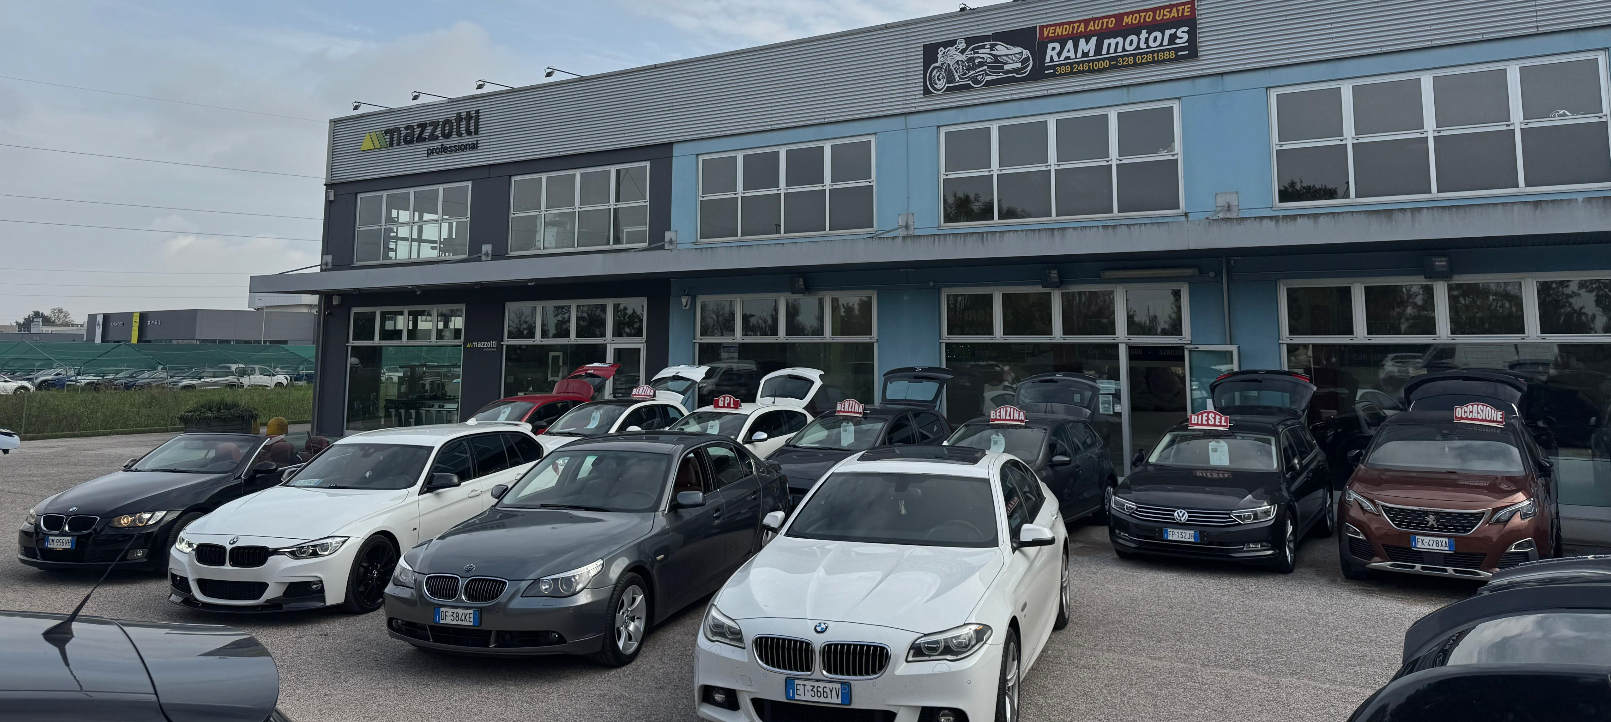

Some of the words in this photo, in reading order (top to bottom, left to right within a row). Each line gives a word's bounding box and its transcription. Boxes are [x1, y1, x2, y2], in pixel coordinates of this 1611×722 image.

[1043, 23, 1085, 37] VENDITA
[1087, 18, 1115, 31] AUTO
[1123, 12, 1153, 25] MOTO
[1156, 5, 1191, 20] USATE
[1045, 36, 1097, 63] RAM
[1102, 27, 1190, 54] motors
[1055, 65, 1071, 75] 389
[1073, 60, 1109, 72] 2461000
[1117, 56, 1133, 66] 328
[1136, 50, 1176, 64] 0281888
[380, 109, 480, 148] mazzotti
[427, 140, 479, 158] professional
[472, 340, 498, 348] mazzotti
[632, 384, 655, 396] BENZINA
[718, 397, 735, 408] GPL
[836, 401, 863, 413] BENZINA
[990, 406, 1025, 420] BENZINA
[1191, 413, 1227, 426] DIESEL
[1455, 404, 1503, 422] OCCASIONE
